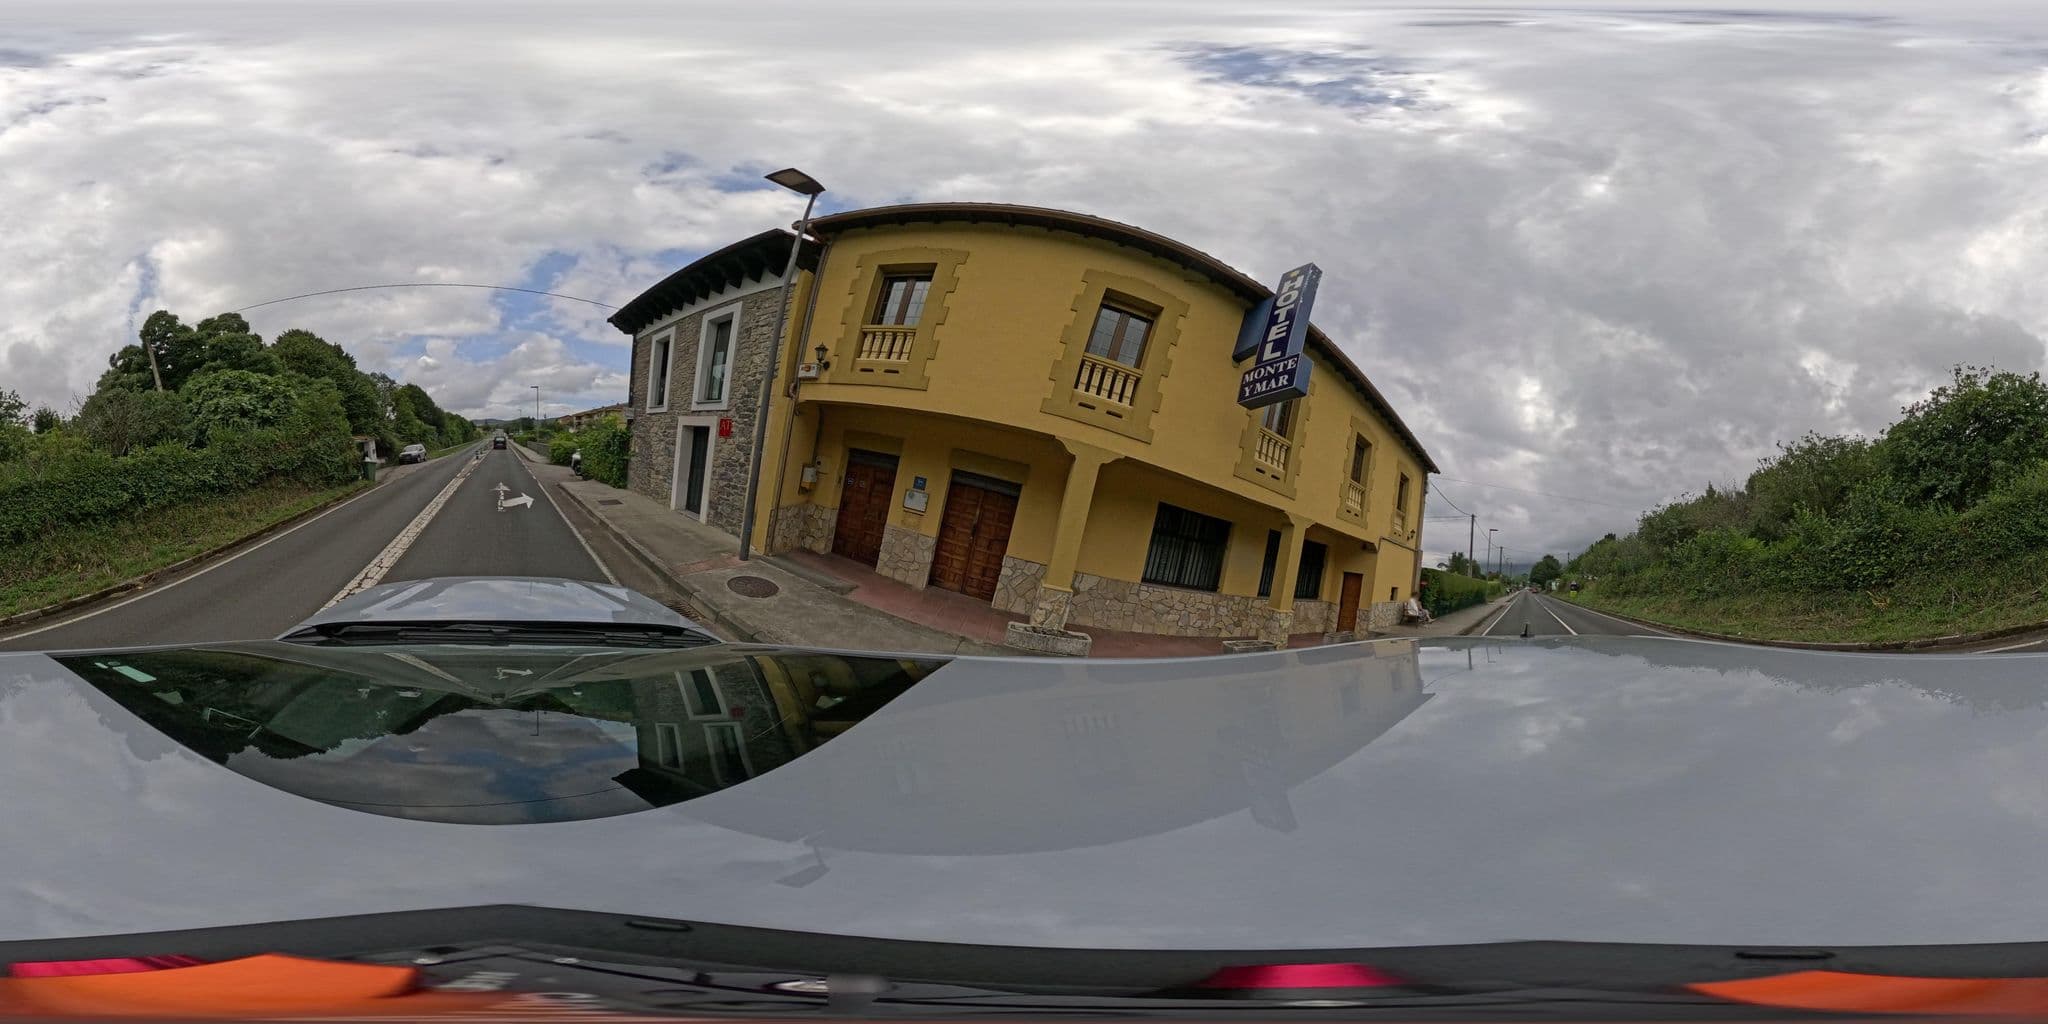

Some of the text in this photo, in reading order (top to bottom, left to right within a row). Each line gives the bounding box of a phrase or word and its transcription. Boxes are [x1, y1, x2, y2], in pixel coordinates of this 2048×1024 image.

[1263, 275, 1304, 362] HOTEL
[1243, 357, 1298, 385] MONTE
[1243, 374, 1289, 398] Y MAR
